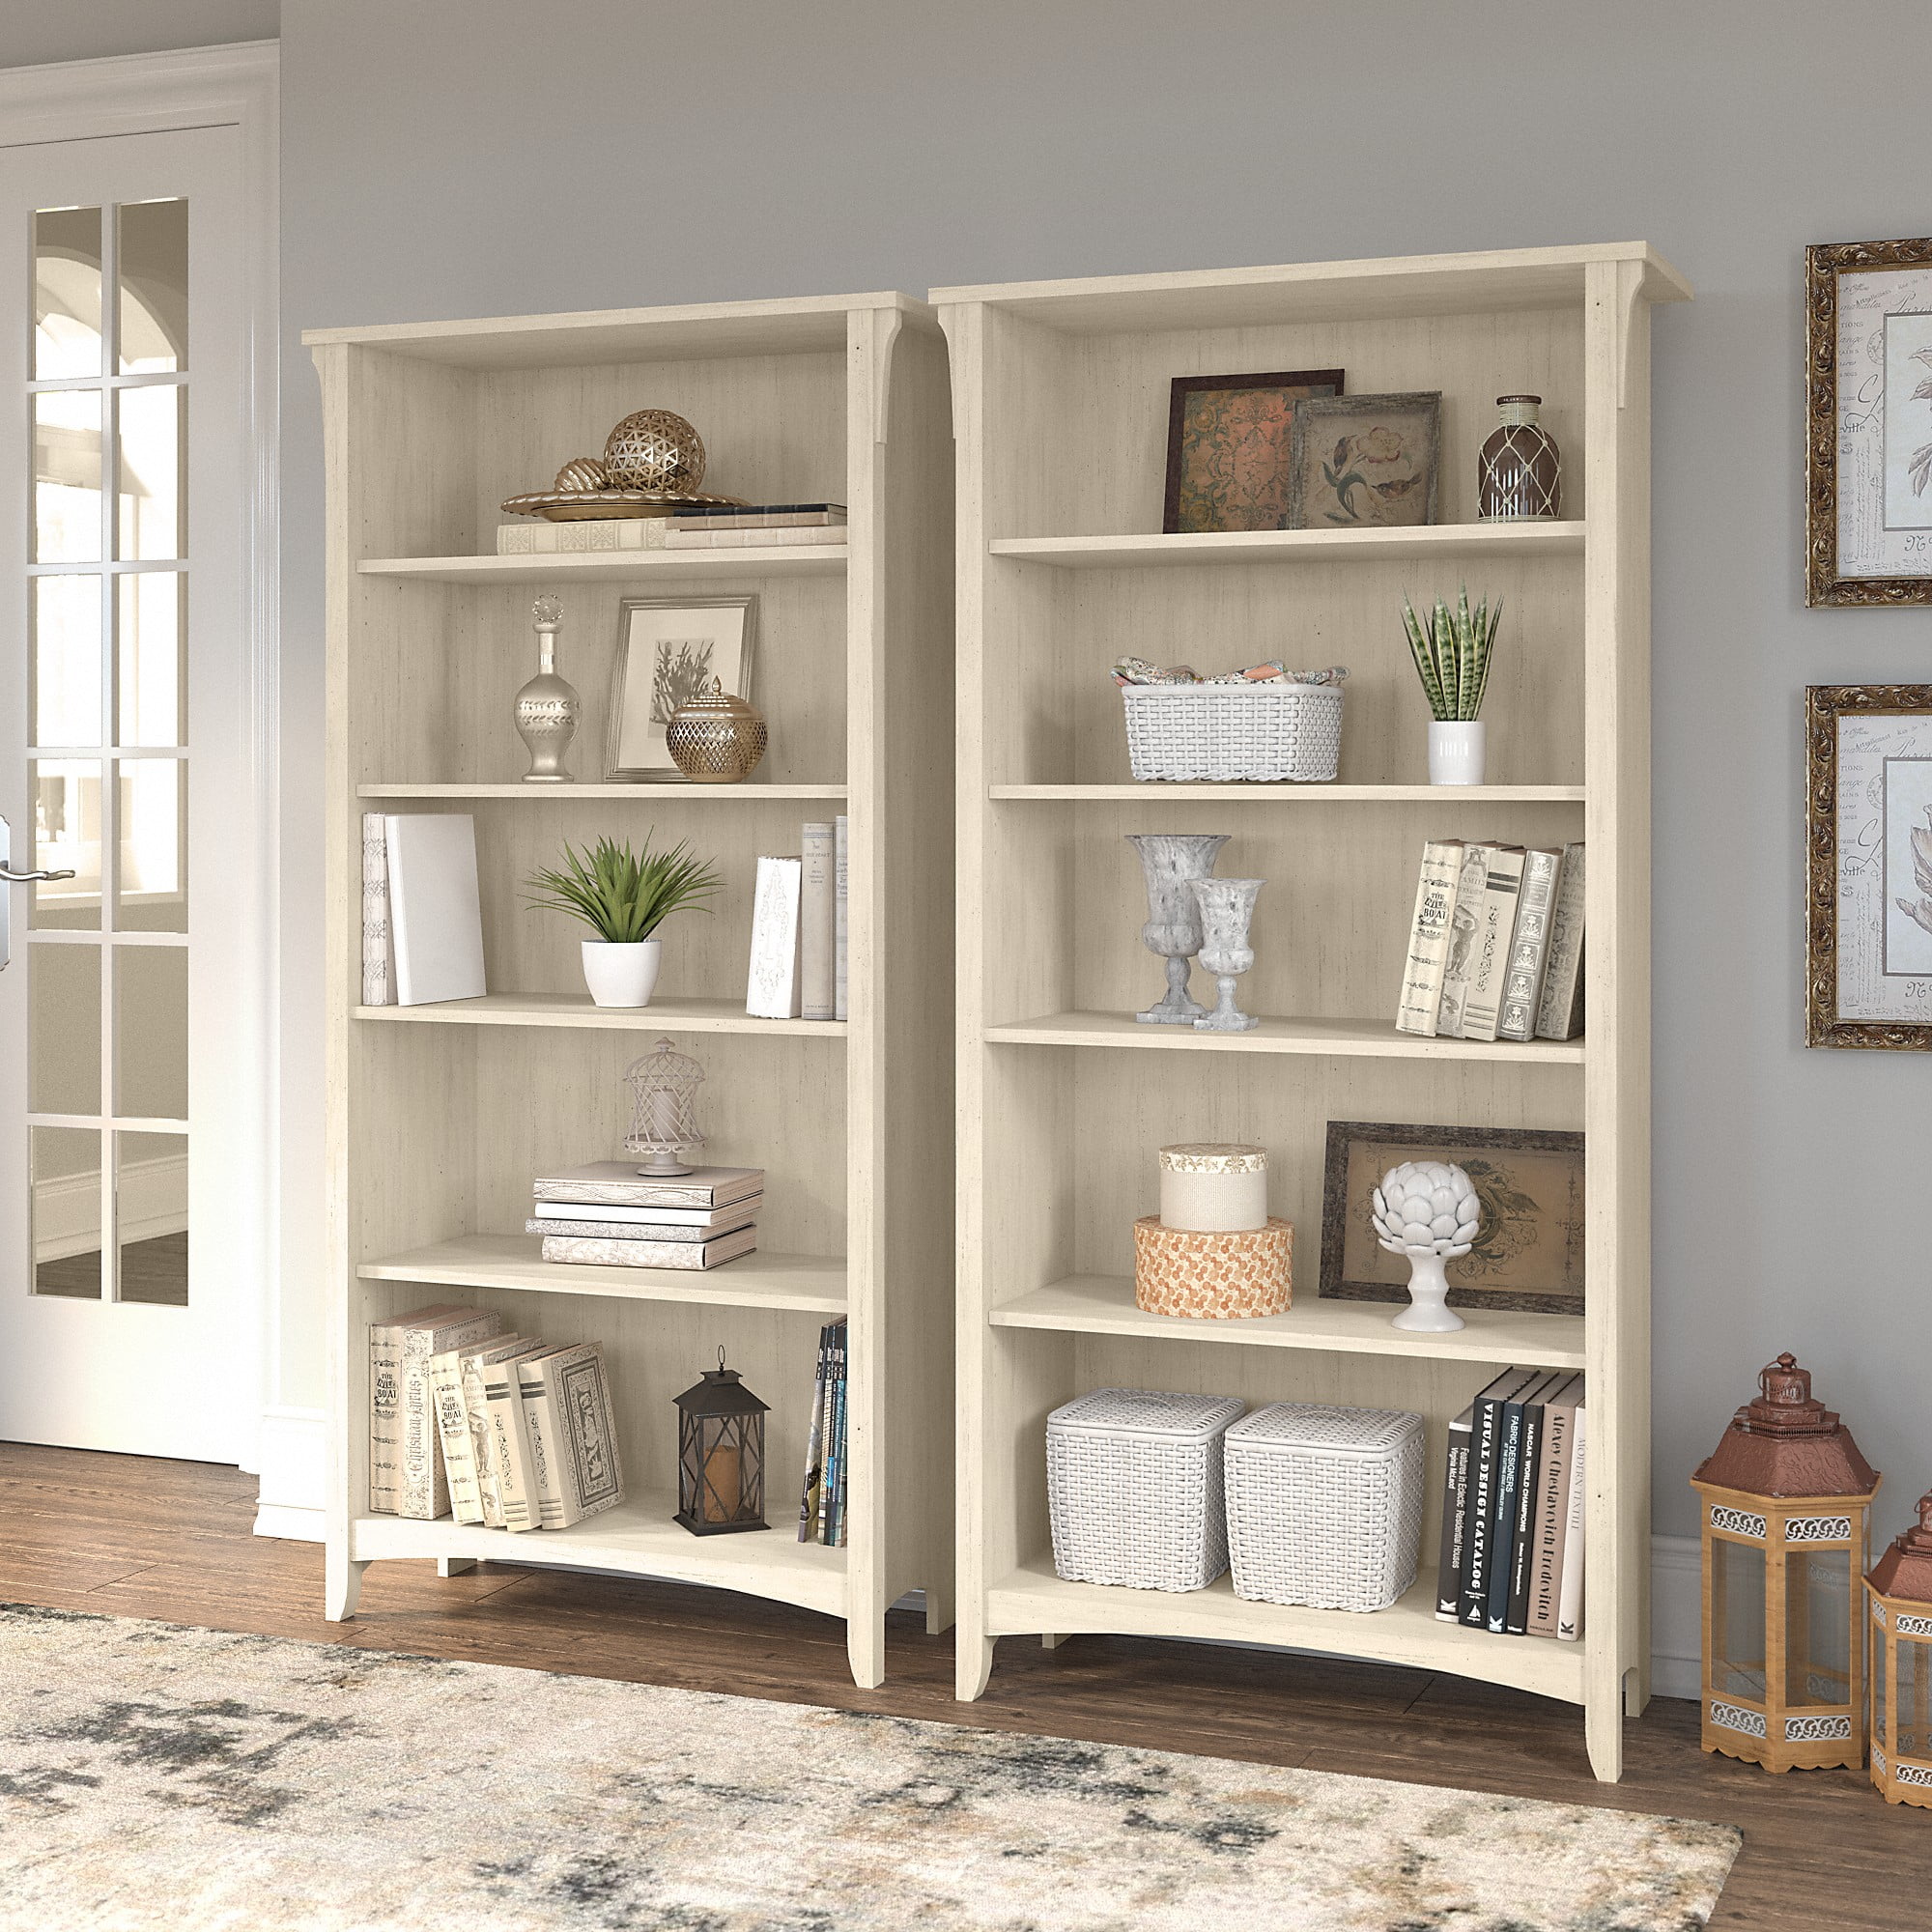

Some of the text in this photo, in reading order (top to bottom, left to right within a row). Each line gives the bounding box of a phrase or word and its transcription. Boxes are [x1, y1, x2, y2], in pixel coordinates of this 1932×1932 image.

[1481, 1403, 1493, 1459] VISUAL
[1525, 1423, 1534, 1458] NASCAR
[1550, 1413, 1565, 1457] Alexey
[1448, 1447, 1459, 1489] Virginia McLeod
[1459, 1447, 1469, 1475] Features
[1506, 1415, 1519, 1492] FABRIC DESIGNERS
[1575, 1437, 1586, 1486] MODERN
[1457, 1483, 1467, 1507] Eclectic
[1476, 1463, 1490, 1518] DESIGN
[1520, 1489, 1528, 1532] CHAMPIONS
[1454, 1510, 1464, 1545] Residential
[1452, 1546, 1463, 1569] Houses
[1471, 1520, 1485, 1589] CATALOG
